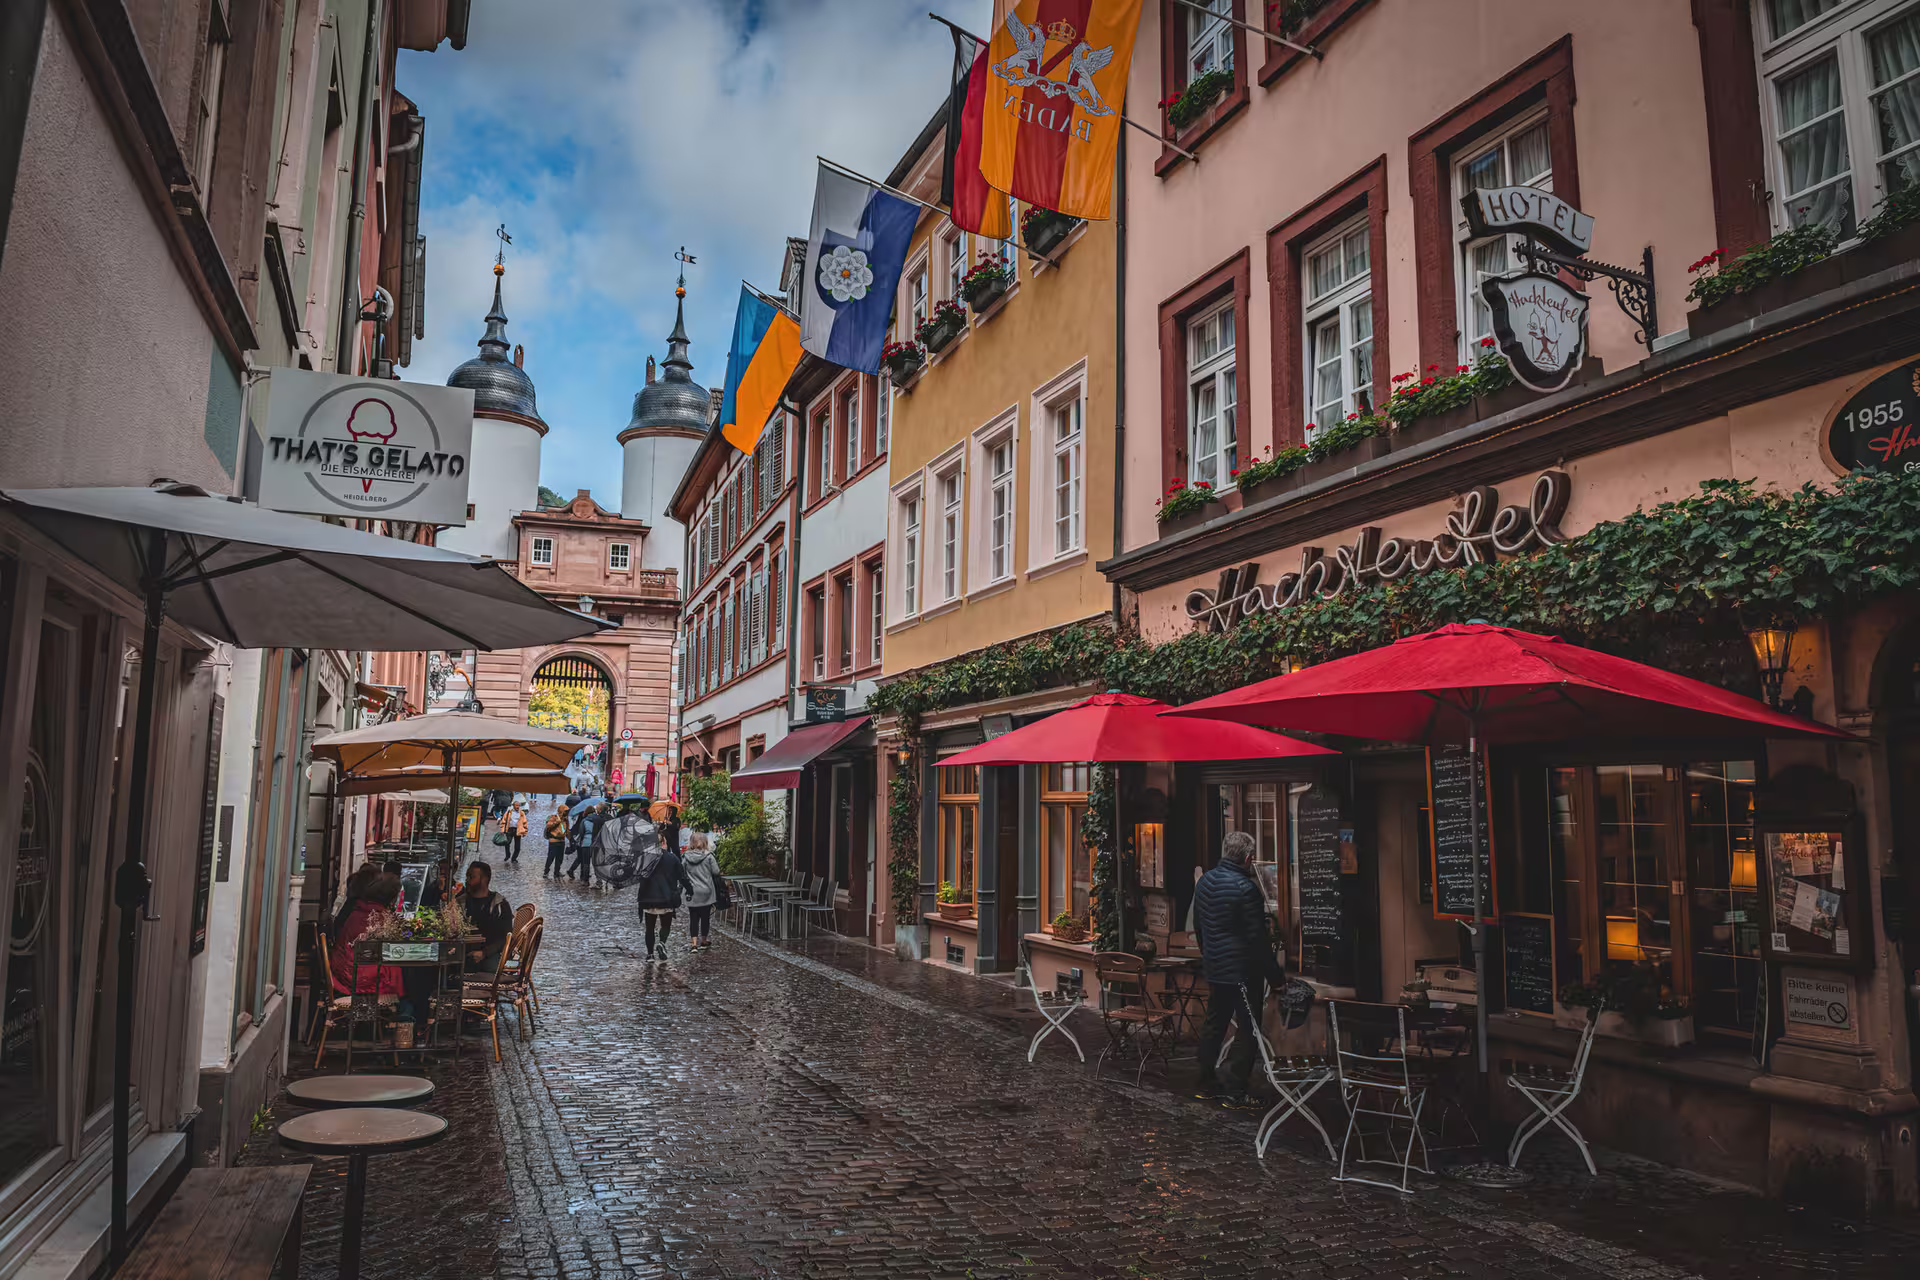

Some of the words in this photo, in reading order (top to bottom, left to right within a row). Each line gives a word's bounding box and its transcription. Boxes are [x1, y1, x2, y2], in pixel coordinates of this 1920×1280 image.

[1487, 191, 1586, 242] HOTEL
[1508, 284, 1579, 323] Hackteufel
[1844, 399, 1904, 432] 1955
[270, 436, 359, 466] THAT'S
[368, 446, 465, 477] GELATO
[321, 463, 339, 473] DIE
[343, 464, 416, 480] EISMACHEREI
[343, 493, 388, 503] HEIDELBERG
[1184, 471, 1572, 632] Hackteufel
[1788, 979, 1813, 991] Bitte
[1789, 1008, 1827, 1022] abstellen
